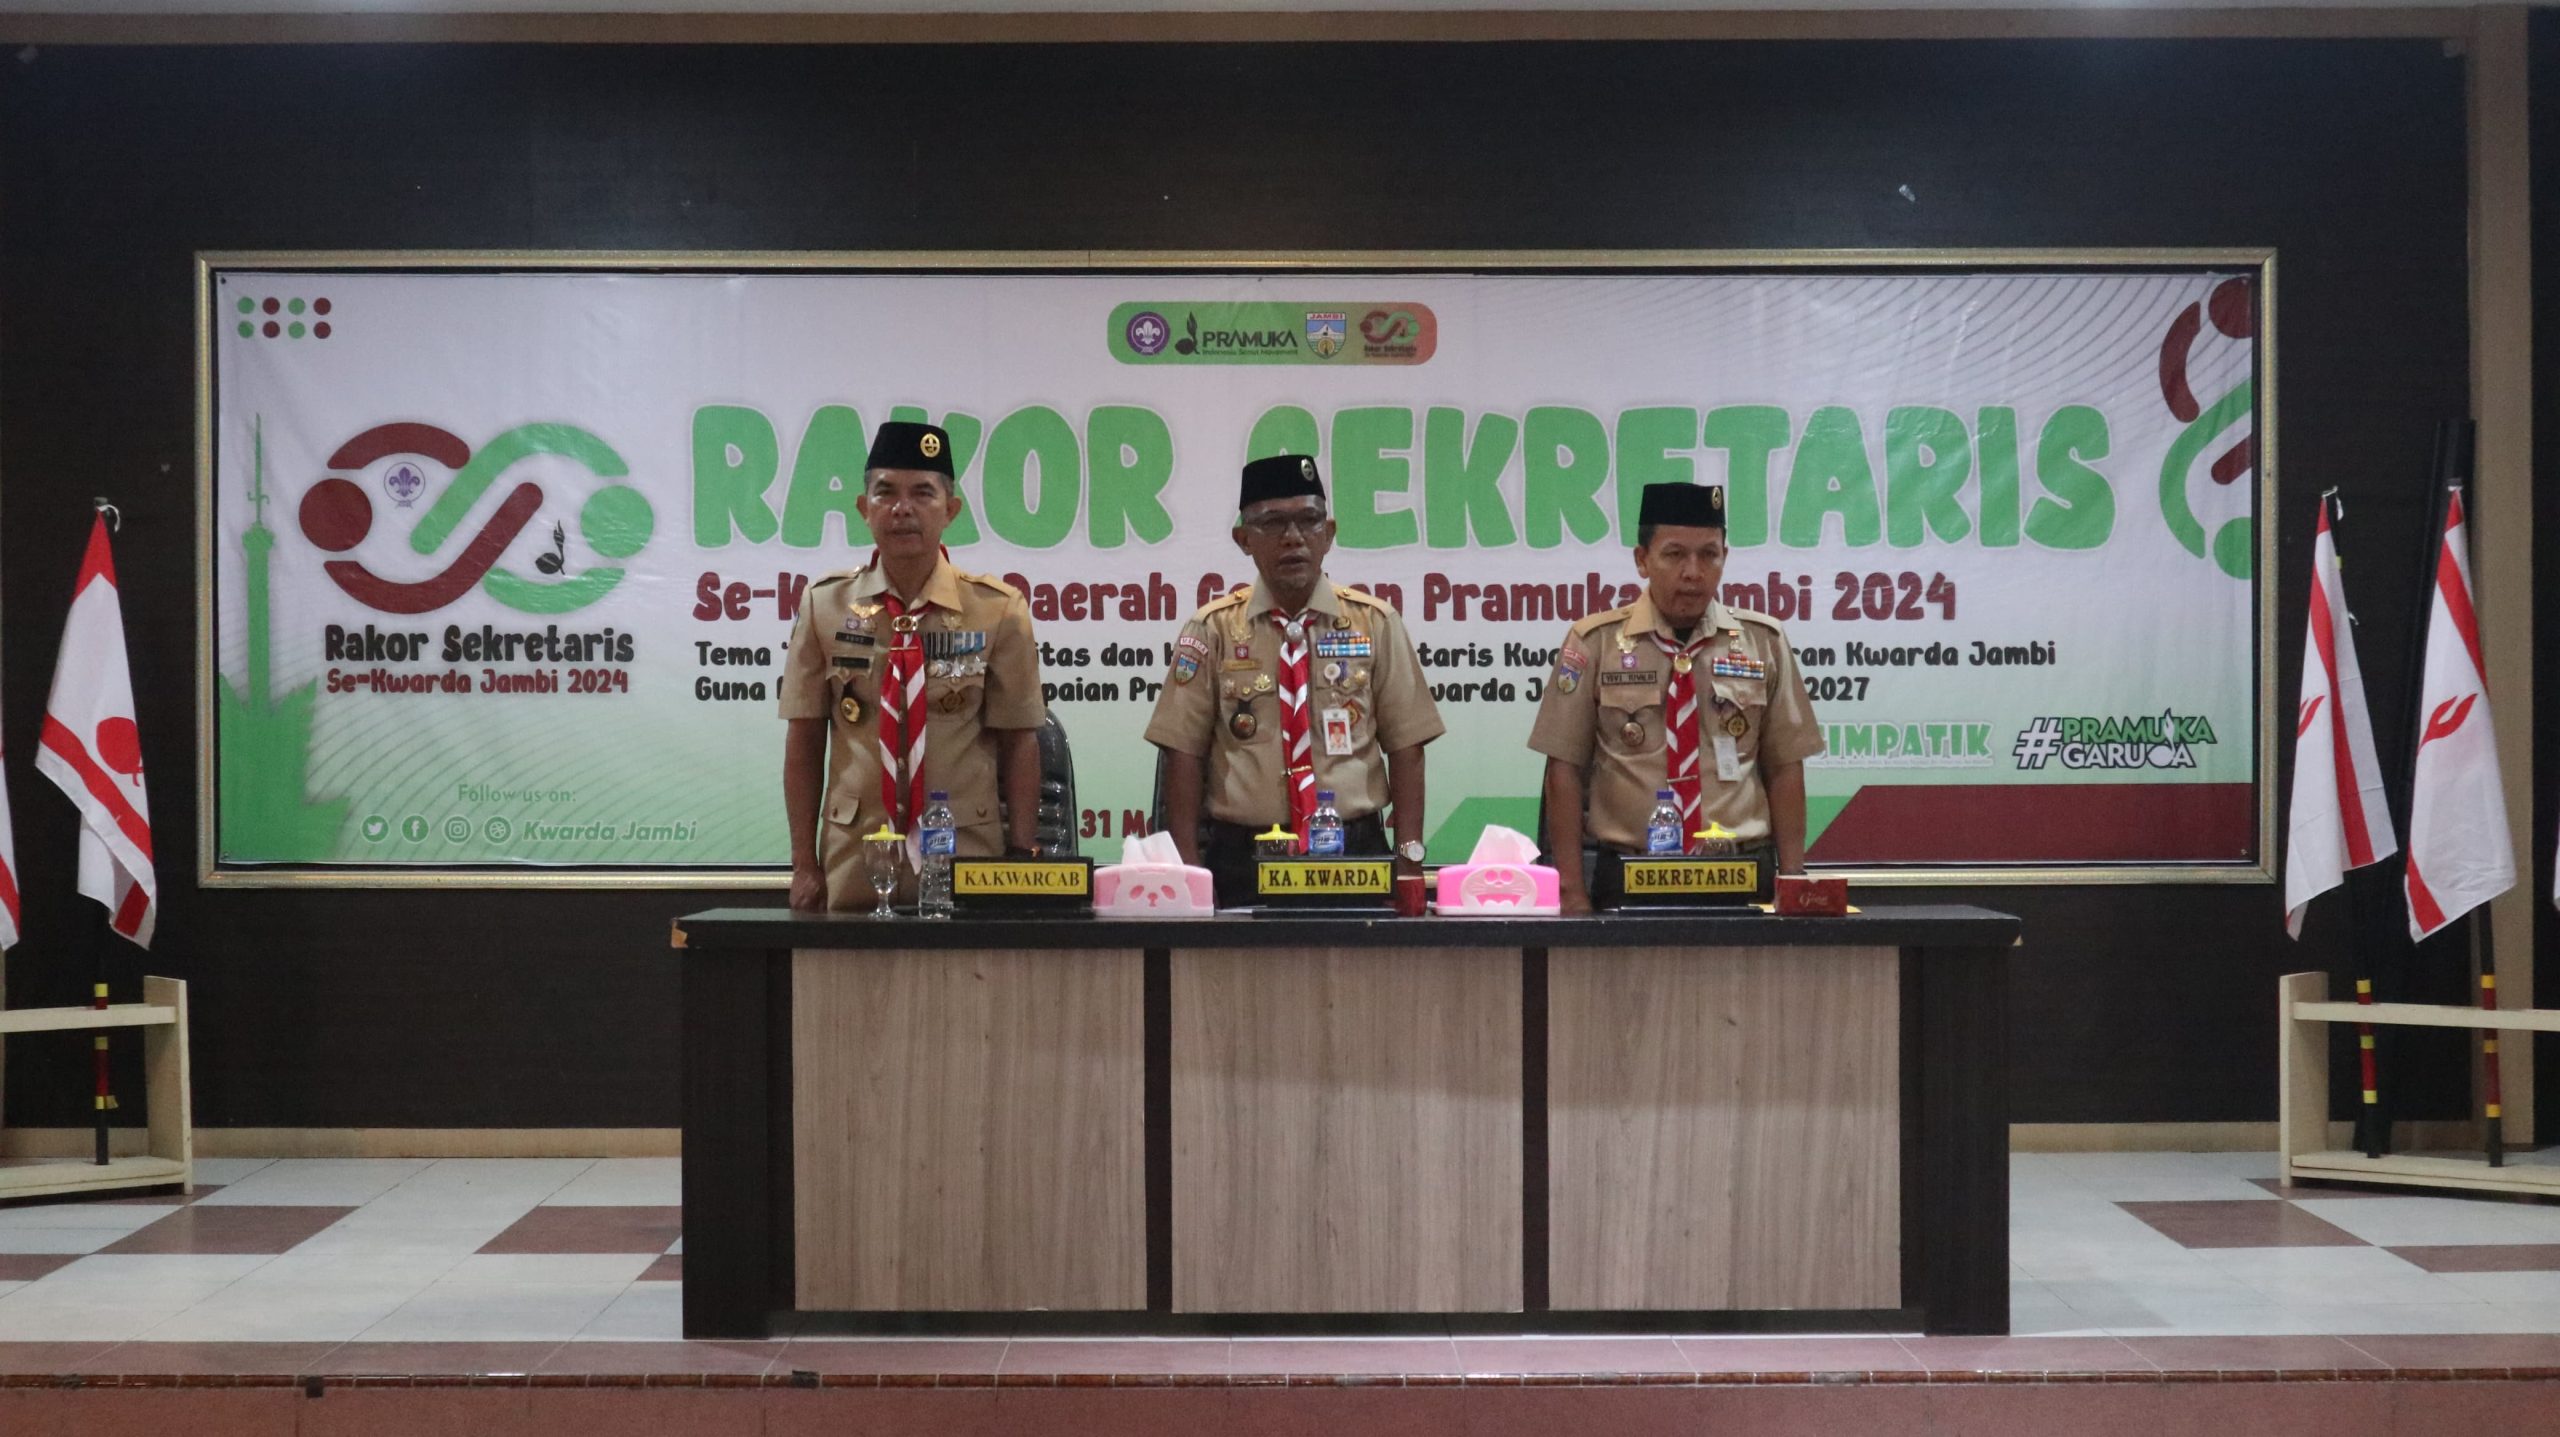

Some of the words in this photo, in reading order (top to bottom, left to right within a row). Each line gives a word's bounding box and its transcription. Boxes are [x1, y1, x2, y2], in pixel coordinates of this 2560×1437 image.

[1202, 329, 1298, 347] PRAMUKA
[1714, 572, 1812, 621] mbi
[1832, 571, 1956, 621] 2024
[325, 624, 429, 662] Rakor
[442, 624, 634, 662] Sekretaris
[695, 641, 771, 666] Tema
[1101, 642, 1153, 667] dan
[1417, 642, 1494, 667] taris
[1846, 641, 1959, 666] Kwarda
[1969, 640, 2056, 666] Jambi
[326, 668, 472, 693] Se-Kwarda
[480, 668, 558, 693] Jambi
[567, 668, 629, 693] 2024
[695, 676, 766, 701] Guna
[1042, 677, 1119, 702] paian
[1430, 678, 1516, 702] warda
[1804, 676, 1870, 701] 2027
[1819, 723, 1993, 757] IMPATIK
[458, 784, 516, 802] Follow
[523, 789, 542, 802] us
[548, 789, 577, 802] on:
[523, 821, 616, 841] Kwarda
[621, 820, 697, 841] Jambi
[1079, 809, 1111, 838] 31
[964, 870, 1080, 888] KA.KWARCAB
[1269, 869, 1298, 887] KA.
[1305, 869, 1381, 887] KWARDA
[1635, 868, 1747, 886] SEKRETARIS
